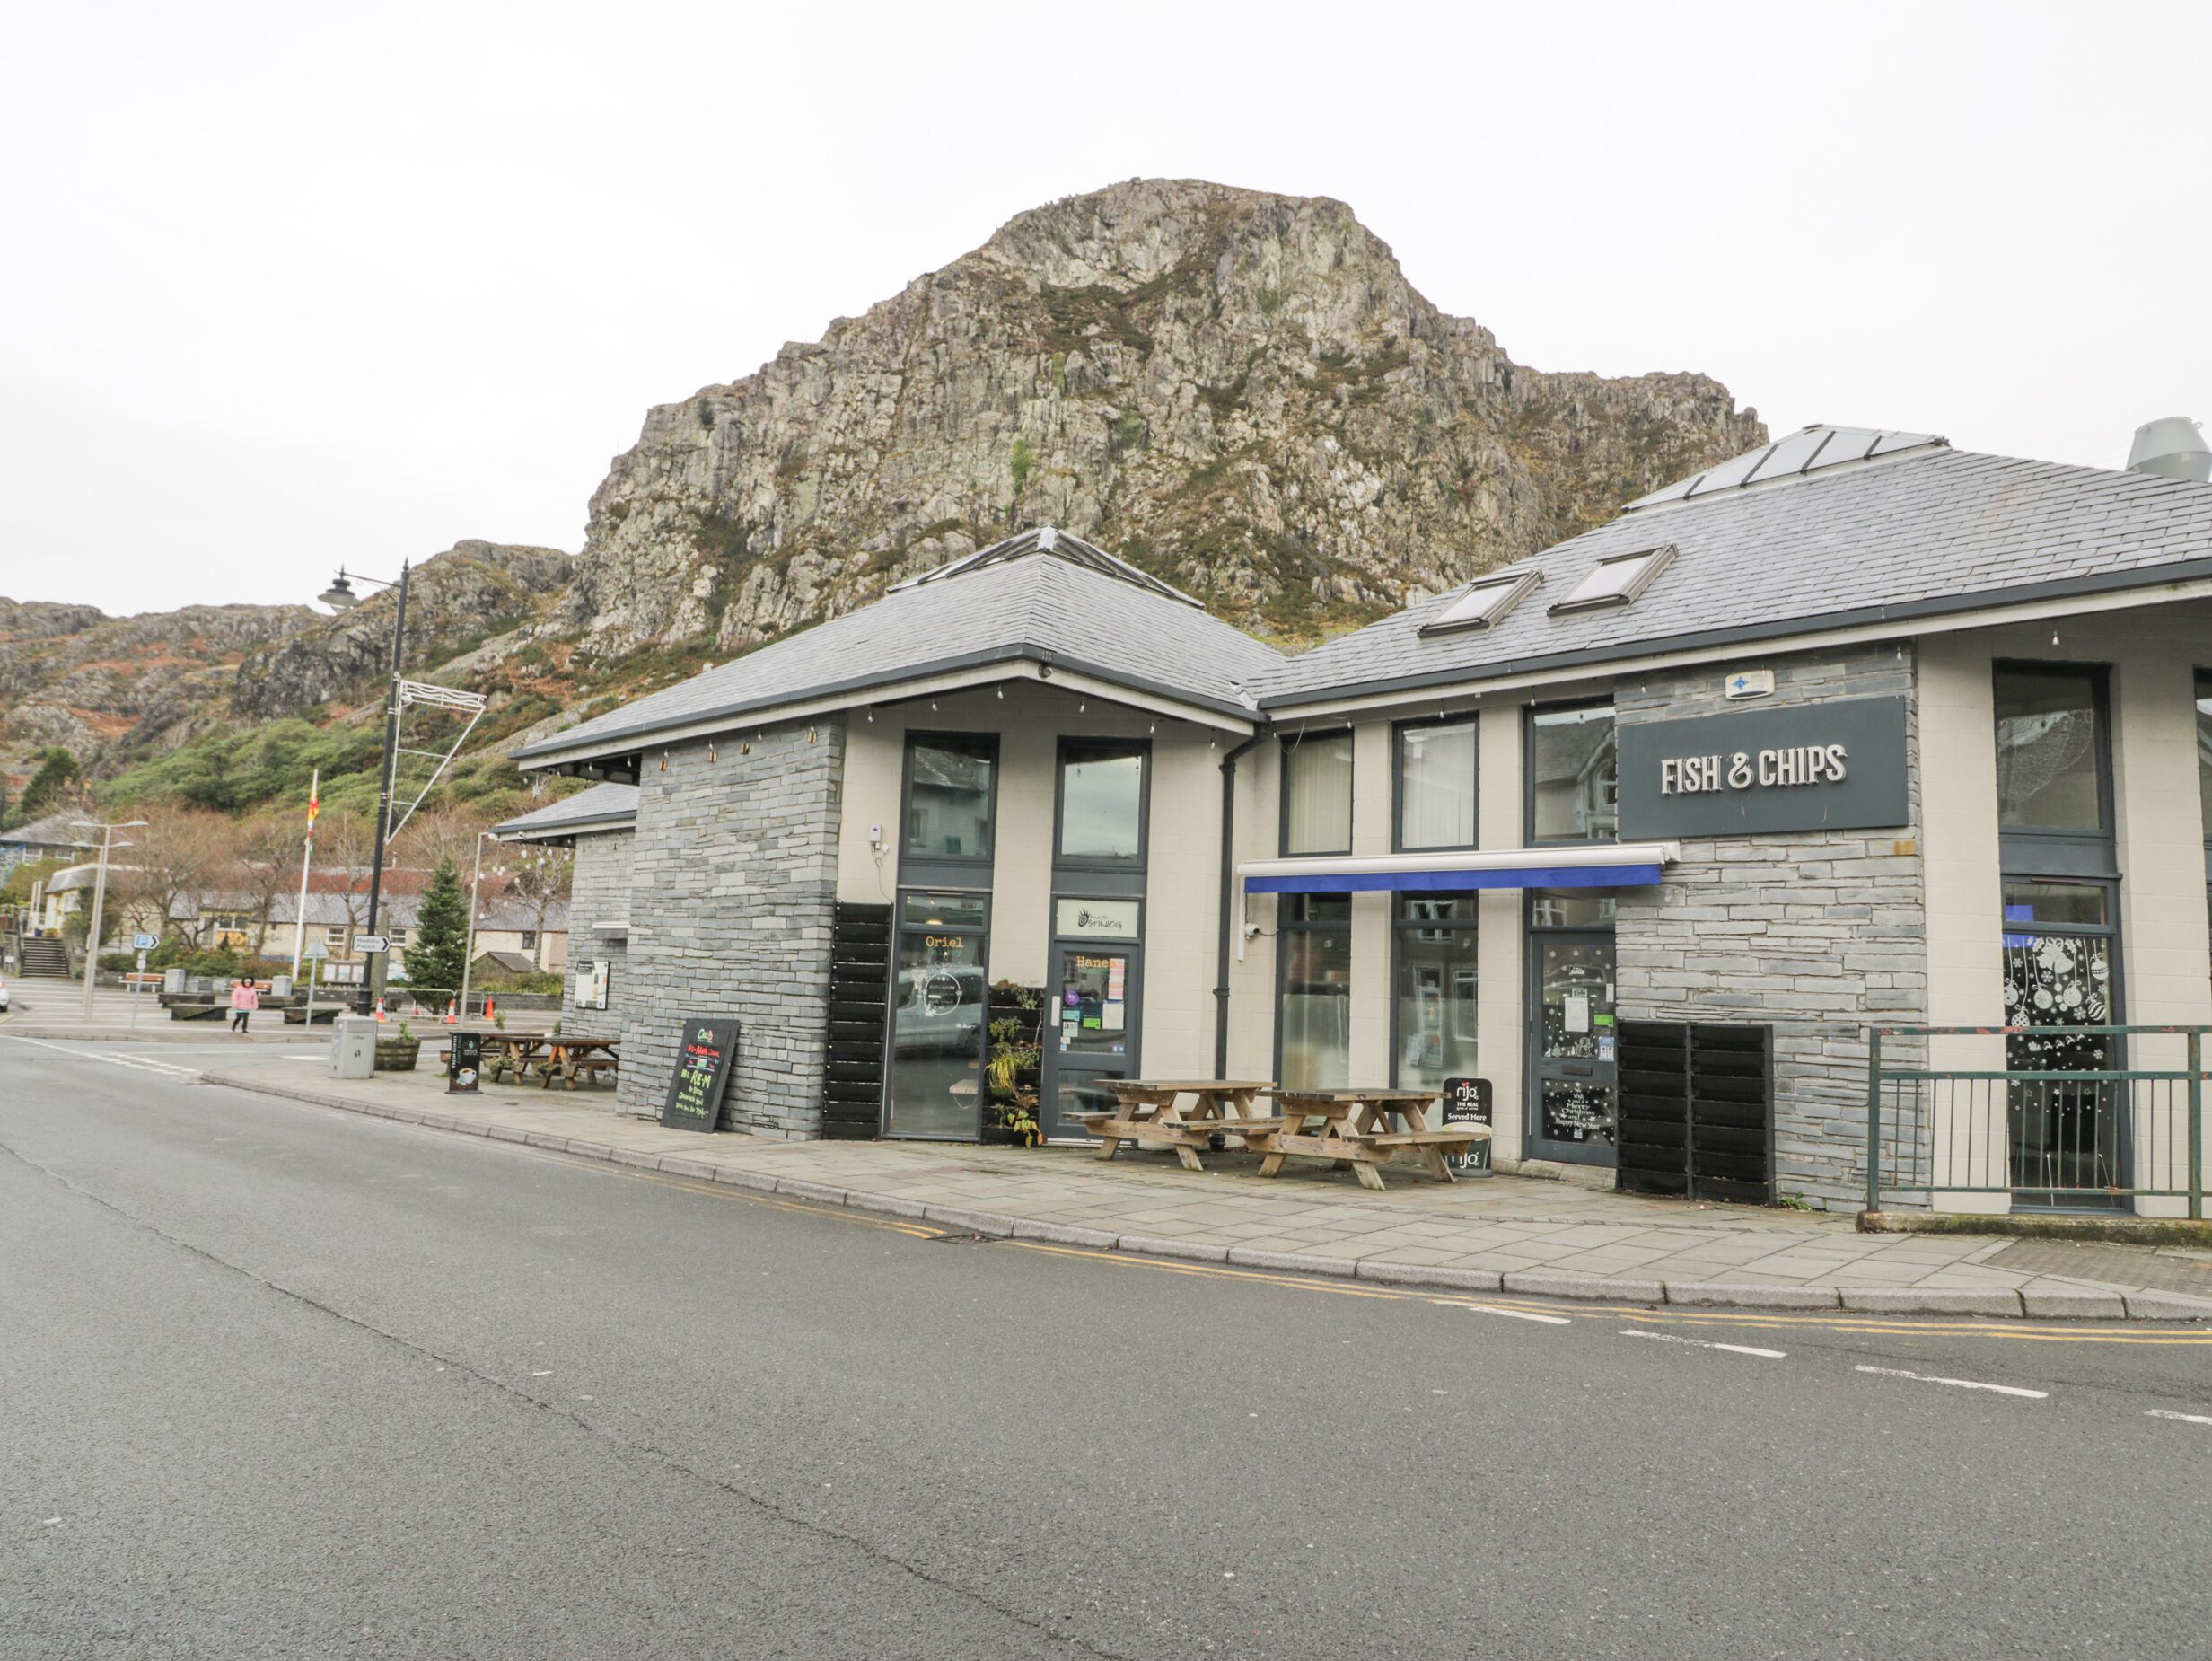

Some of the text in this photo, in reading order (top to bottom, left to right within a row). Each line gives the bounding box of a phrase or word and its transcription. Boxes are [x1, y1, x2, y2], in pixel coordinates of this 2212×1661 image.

[1661, 744, 1848, 795] FISH & CHIPS
[926, 936, 963, 948] Oriel
[1076, 955, 1116, 968] Hanes
[1456, 1085, 1478, 1101] rijo
[1470, 1113, 1487, 1121] Here
[1556, 1118, 1574, 1127] Happy
[1587, 1122, 1601, 1130] Year
